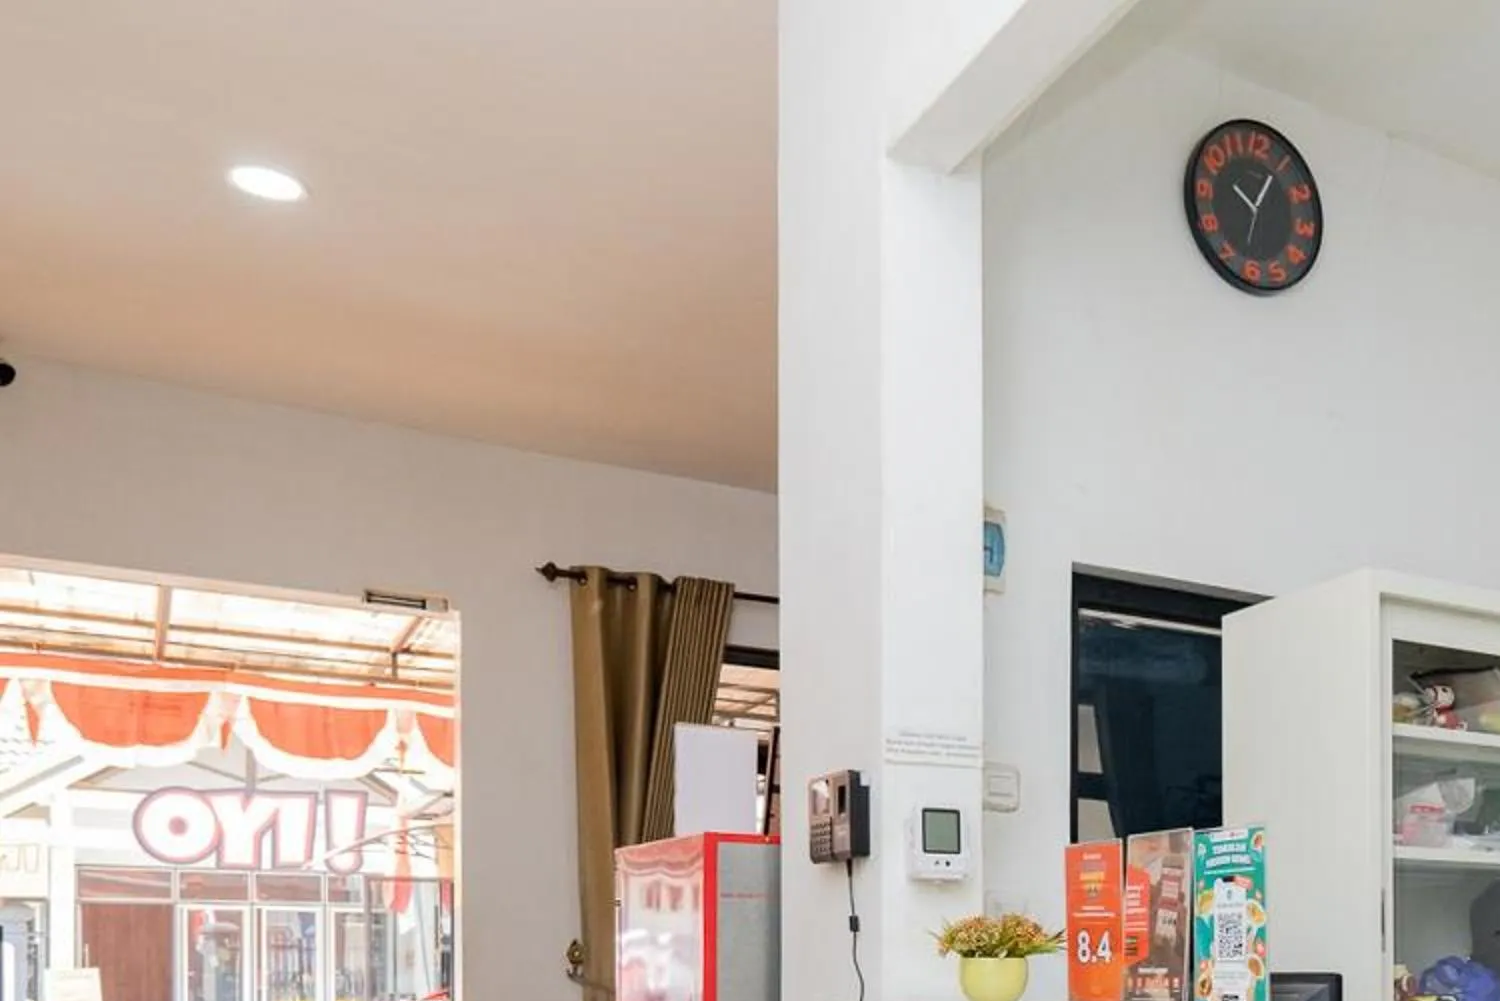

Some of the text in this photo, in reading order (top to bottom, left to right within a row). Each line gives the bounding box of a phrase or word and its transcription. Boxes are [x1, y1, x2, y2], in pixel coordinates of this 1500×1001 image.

[1250, 131, 1271, 161] 12
[1296, 219, 1315, 239] 3
[1243, 260, 1261, 283] 6
[1268, 260, 1286, 282] 5
[1077, 929, 1112, 964] 8.4
